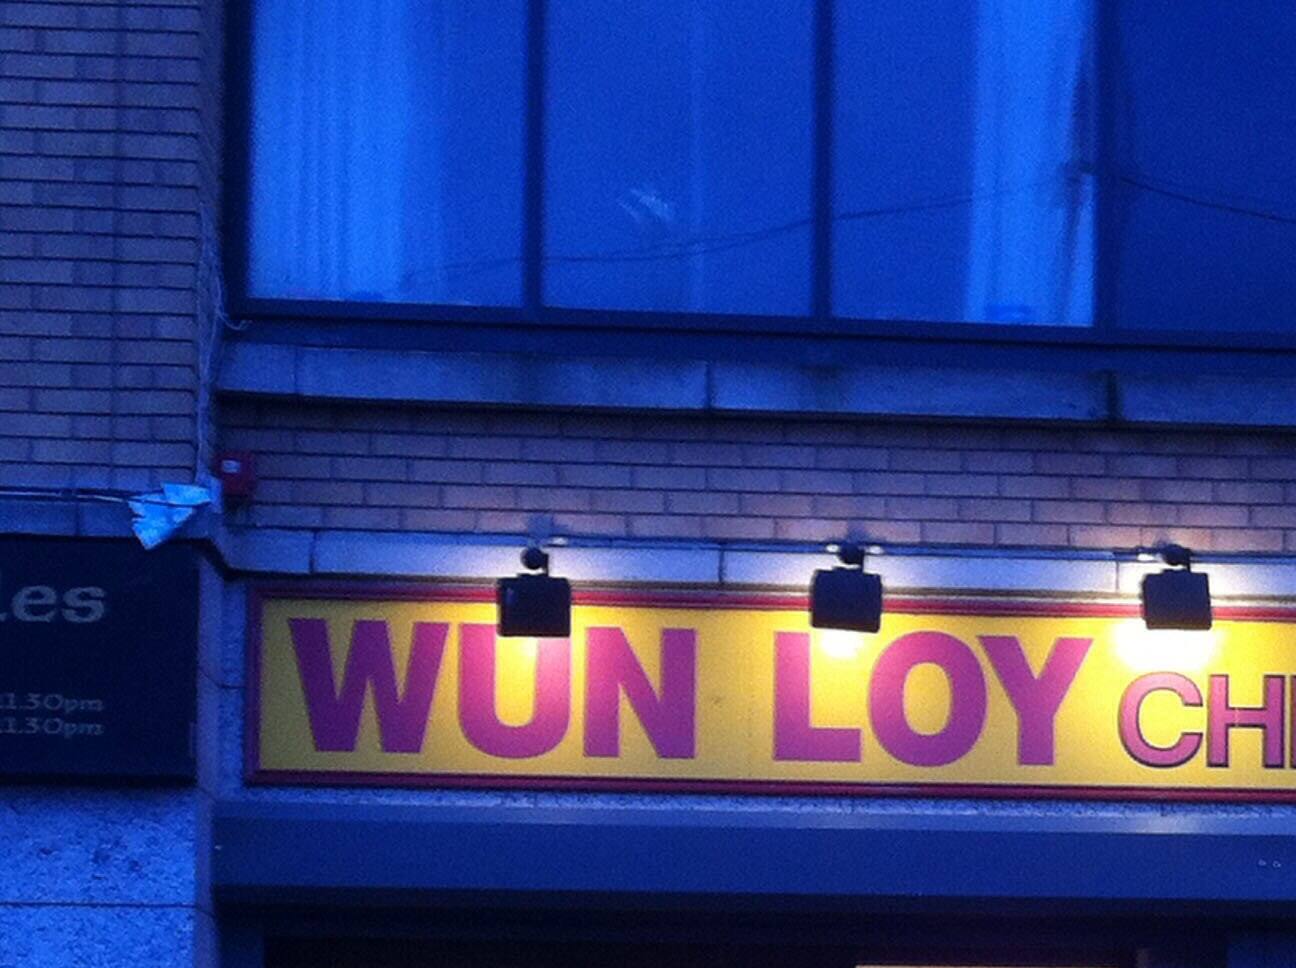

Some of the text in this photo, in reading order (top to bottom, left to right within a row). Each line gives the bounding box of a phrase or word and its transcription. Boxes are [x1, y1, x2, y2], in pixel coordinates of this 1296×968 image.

[0, 585, 107, 623] es
[288, 617, 697, 759] WUN
[772, 630, 1093, 767] LOY
